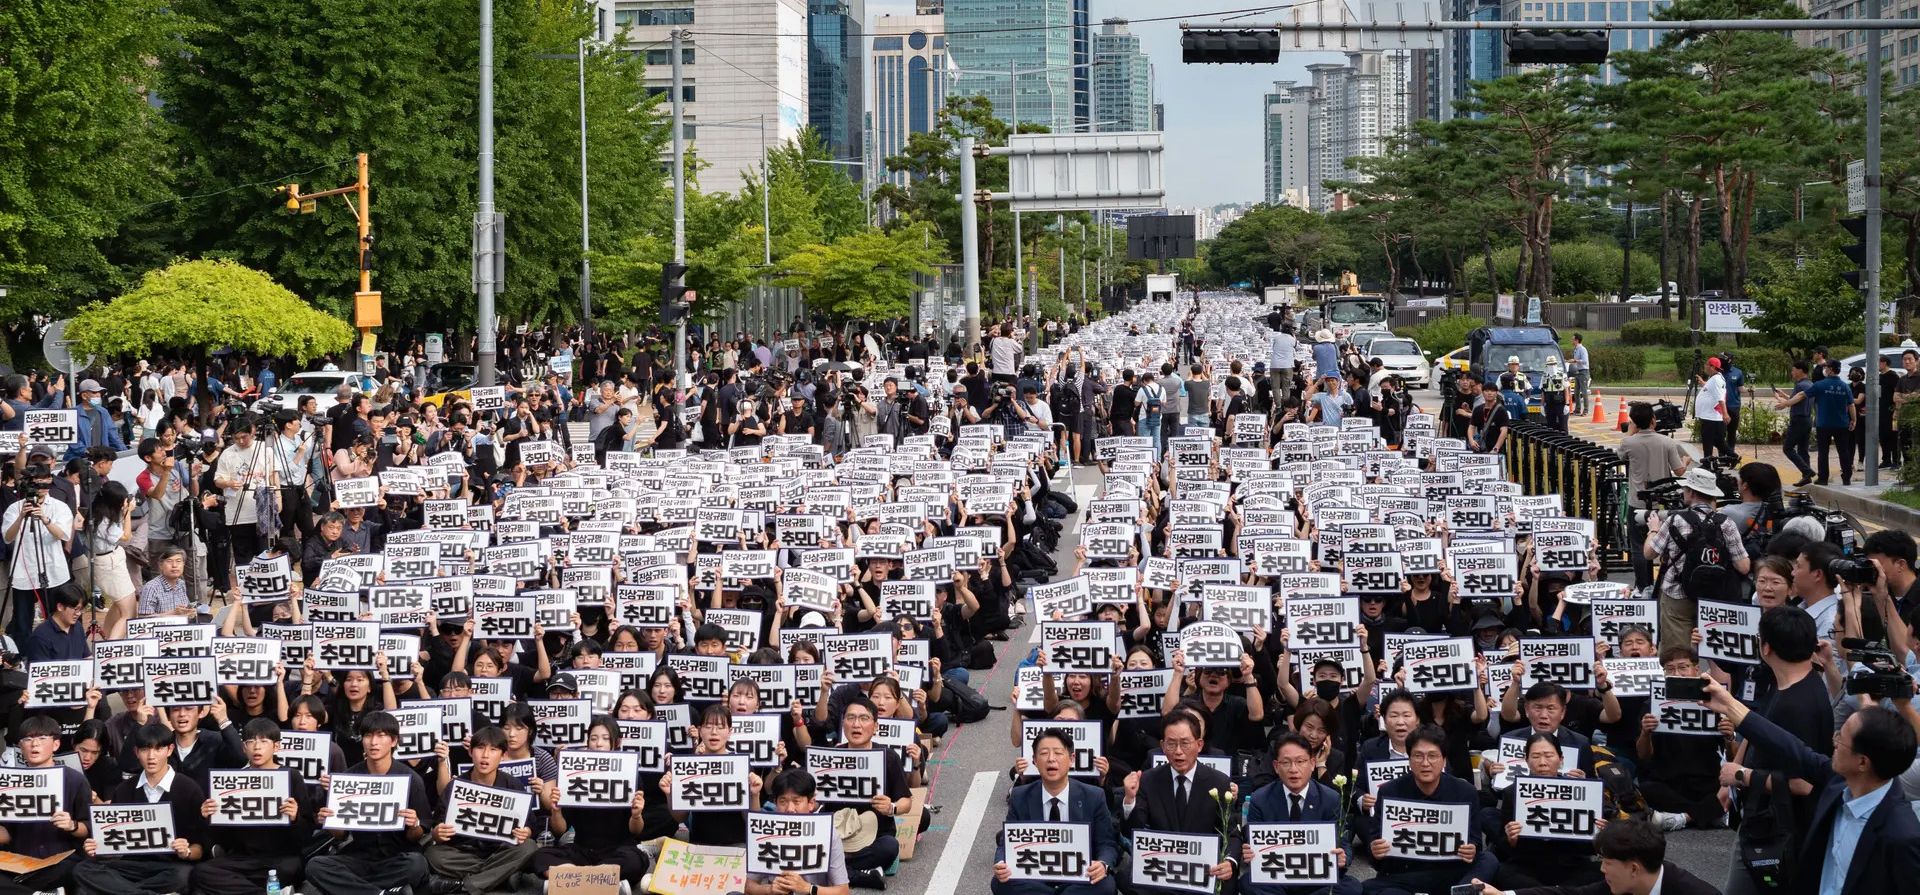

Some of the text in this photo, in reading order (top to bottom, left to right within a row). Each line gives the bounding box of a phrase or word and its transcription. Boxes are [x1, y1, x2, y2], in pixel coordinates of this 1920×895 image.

[1708, 303, 1753, 315] 안전하고
[476, 397, 503, 409] 추모다
[26, 412, 67, 424] 진상규명이
[30, 426, 74, 442] 추모다
[1238, 423, 1263, 433] 추모다
[521, 444, 547, 452] 진상규명이
[1175, 443, 1203, 451] 진상규명이
[525, 453, 551, 464] 추모다
[1179, 453, 1209, 465] 추모다
[1285, 453, 1312, 462] 추모다
[1459, 456, 1491, 464] 진상규명이
[631, 469, 659, 477] 진상규명이
[1422, 475, 1455, 483] 진상규명이
[336, 480, 370, 489] 진상규명이
[388, 480, 417, 492] 추모다
[973, 485, 1011, 494] 진상규명이
[1250, 480, 1282, 489] 진상규명이
[342, 491, 374, 505] 추모다
[740, 489, 772, 498] 진상규명이
[806, 494, 841, 502] 진상규명이
[909, 494, 941, 502] 진상규명이
[1425, 487, 1462, 501] 추모다
[425, 502, 458, 512] 진상규명이
[522, 500, 555, 508] 진상규명이
[971, 502, 1004, 512] 추모다
[1093, 503, 1130, 513] 진상규명이
[1172, 503, 1208, 512] 진상규명이
[1381, 500, 1418, 509] 진상규명이
[1447, 498, 1486, 508] 진상규명이
[1514, 497, 1552, 505] 진상규명이
[663, 509, 697, 520] 추모다
[699, 511, 734, 520] 진상규명이
[809, 504, 844, 516] 추모다
[881, 505, 916, 514] 진상규명이
[1321, 511, 1360, 520] 진상규명이
[429, 514, 464, 529] 추모다
[777, 518, 814, 527] 진상규명이
[1247, 513, 1286, 522] 진상규명이
[1452, 512, 1493, 527] 추모다
[499, 524, 531, 533] 진상규명이
[701, 524, 738, 539] 추모다
[1087, 525, 1124, 535] 진상규명이
[1542, 520, 1584, 530] 진상규명이
[571, 534, 610, 544] 진상규명이
[782, 531, 820, 546] 추모다
[957, 528, 991, 538] 진상규명이
[1172, 534, 1212, 544] 진상규명이
[1343, 528, 1386, 538] 진상규명이
[935, 539, 973, 548] 진상규명이
[1089, 539, 1129, 554] 추모다
[1256, 542, 1300, 552] 진상규명이
[1537, 536, 1579, 546] 진상규명이
[387, 545, 430, 557] 진상규명이
[487, 548, 529, 560] 진상규명이
[574, 548, 615, 561] 추모다
[725, 551, 766, 560] 진상규명이
[862, 542, 901, 555] 추모다
[627, 557, 664, 566] 진상규명이
[803, 552, 843, 562] 진상규명이
[906, 552, 945, 564] 진상규명이
[1262, 556, 1307, 572] 추모다
[1346, 556, 1392, 567] 진상규명이
[1457, 558, 1505, 569] 진상규명이
[1543, 551, 1587, 568] 추모다
[391, 560, 436, 578] 추모다
[492, 561, 536, 578] 추모다
[639, 568, 677, 581] 진상규명이
[728, 563, 771, 576] 추모다
[1185, 564, 1229, 575] 진상규명이
[564, 571, 601, 582] 진상규명이
[785, 572, 828, 587] 진상규명이
[1282, 576, 1328, 588] 진상규명이
[1351, 573, 1400, 592] 추모다
[1464, 574, 1513, 593] 추모다
[244, 576, 289, 594] 추모다
[882, 584, 924, 596] 진상규명이
[1035, 584, 1079, 600] 진상규명이
[304, 593, 347, 607] 진상규명이
[619, 588, 663, 601] 진상규명이
[788, 586, 836, 607] 추모다
[1206, 588, 1258, 603] 진상규명이
[476, 600, 523, 614] 진상규명이
[886, 600, 931, 618] 추모다
[1289, 603, 1345, 617] 진상규명이
[1594, 604, 1645, 616] 진상규명이
[623, 604, 672, 625] 추모다
[706, 613, 750, 626] 진상규명이
[1211, 605, 1268, 628] 추모다
[1700, 604, 1748, 625] 진상규명이
[315, 626, 366, 638] 진상규명이
[481, 617, 532, 636] 추모다
[1045, 626, 1102, 641] 진상규명이
[1182, 626, 1234, 639] 진상규명이
[1296, 620, 1356, 644] 추모다
[214, 642, 267, 655] 진상규명이
[827, 640, 879, 652] 진상규명이
[1405, 643, 1460, 658] 진상규명이
[1522, 642, 1580, 657] 진상규명이
[1706, 627, 1759, 660] 추모다
[96, 644, 144, 658] 진상규명이
[320, 645, 374, 666] 추모다
[1052, 646, 1111, 669] 추모다
[1186, 640, 1242, 663] 추모다
[31, 665, 80, 678] 진상규명이
[146, 662, 202, 676] 진상규명이
[218, 659, 274, 680] 추모다
[670, 658, 718, 672] 진상규명이
[834, 657, 888, 678] 추모다
[1605, 659, 1660, 671] 진상규명이
[1413, 664, 1472, 687] 추모다
[1530, 662, 1592, 686] 추모다
[35, 682, 88, 703] 추모다
[154, 681, 213, 703] 추모다
[679, 678, 726, 698] 추모다
[1659, 706, 1719, 732] 추모다
[538, 721, 588, 744] 추모다
[562, 756, 623, 774] 진상규명이
[674, 760, 735, 776] 진상규명이
[809, 754, 869, 770] 진상규명이
[213, 775, 274, 791] 진상규명이
[333, 779, 394, 797] 진상규명이
[816, 773, 879, 798] 추모다
[567, 778, 632, 803] 추모다
[681, 781, 744, 805] 추모다
[1518, 782, 1586, 802] 진상규명이
[454, 785, 515, 811] 진상규명이
[220, 797, 282, 820] 추모다
[336, 802, 400, 826] 추모다
[1385, 803, 1453, 823] 진상규명이
[94, 809, 156, 825] 진상규명이
[1526, 805, 1595, 837] 추모다
[455, 807, 520, 842] 추모다
[750, 819, 815, 837] 진상규명이
[104, 829, 170, 852] 추모다
[1007, 827, 1073, 844] 진상규명이
[1252, 828, 1319, 847] 진상규명이
[1391, 827, 1463, 856] 추모다
[1135, 834, 1201, 857] 진상규명이
[757, 842, 826, 871] 추모다
[1015, 850, 1085, 878] 추모다
[1260, 851, 1332, 880] 추모다
[1143, 856, 1210, 888] 추모다
[669, 872, 730, 890] 내리막길
